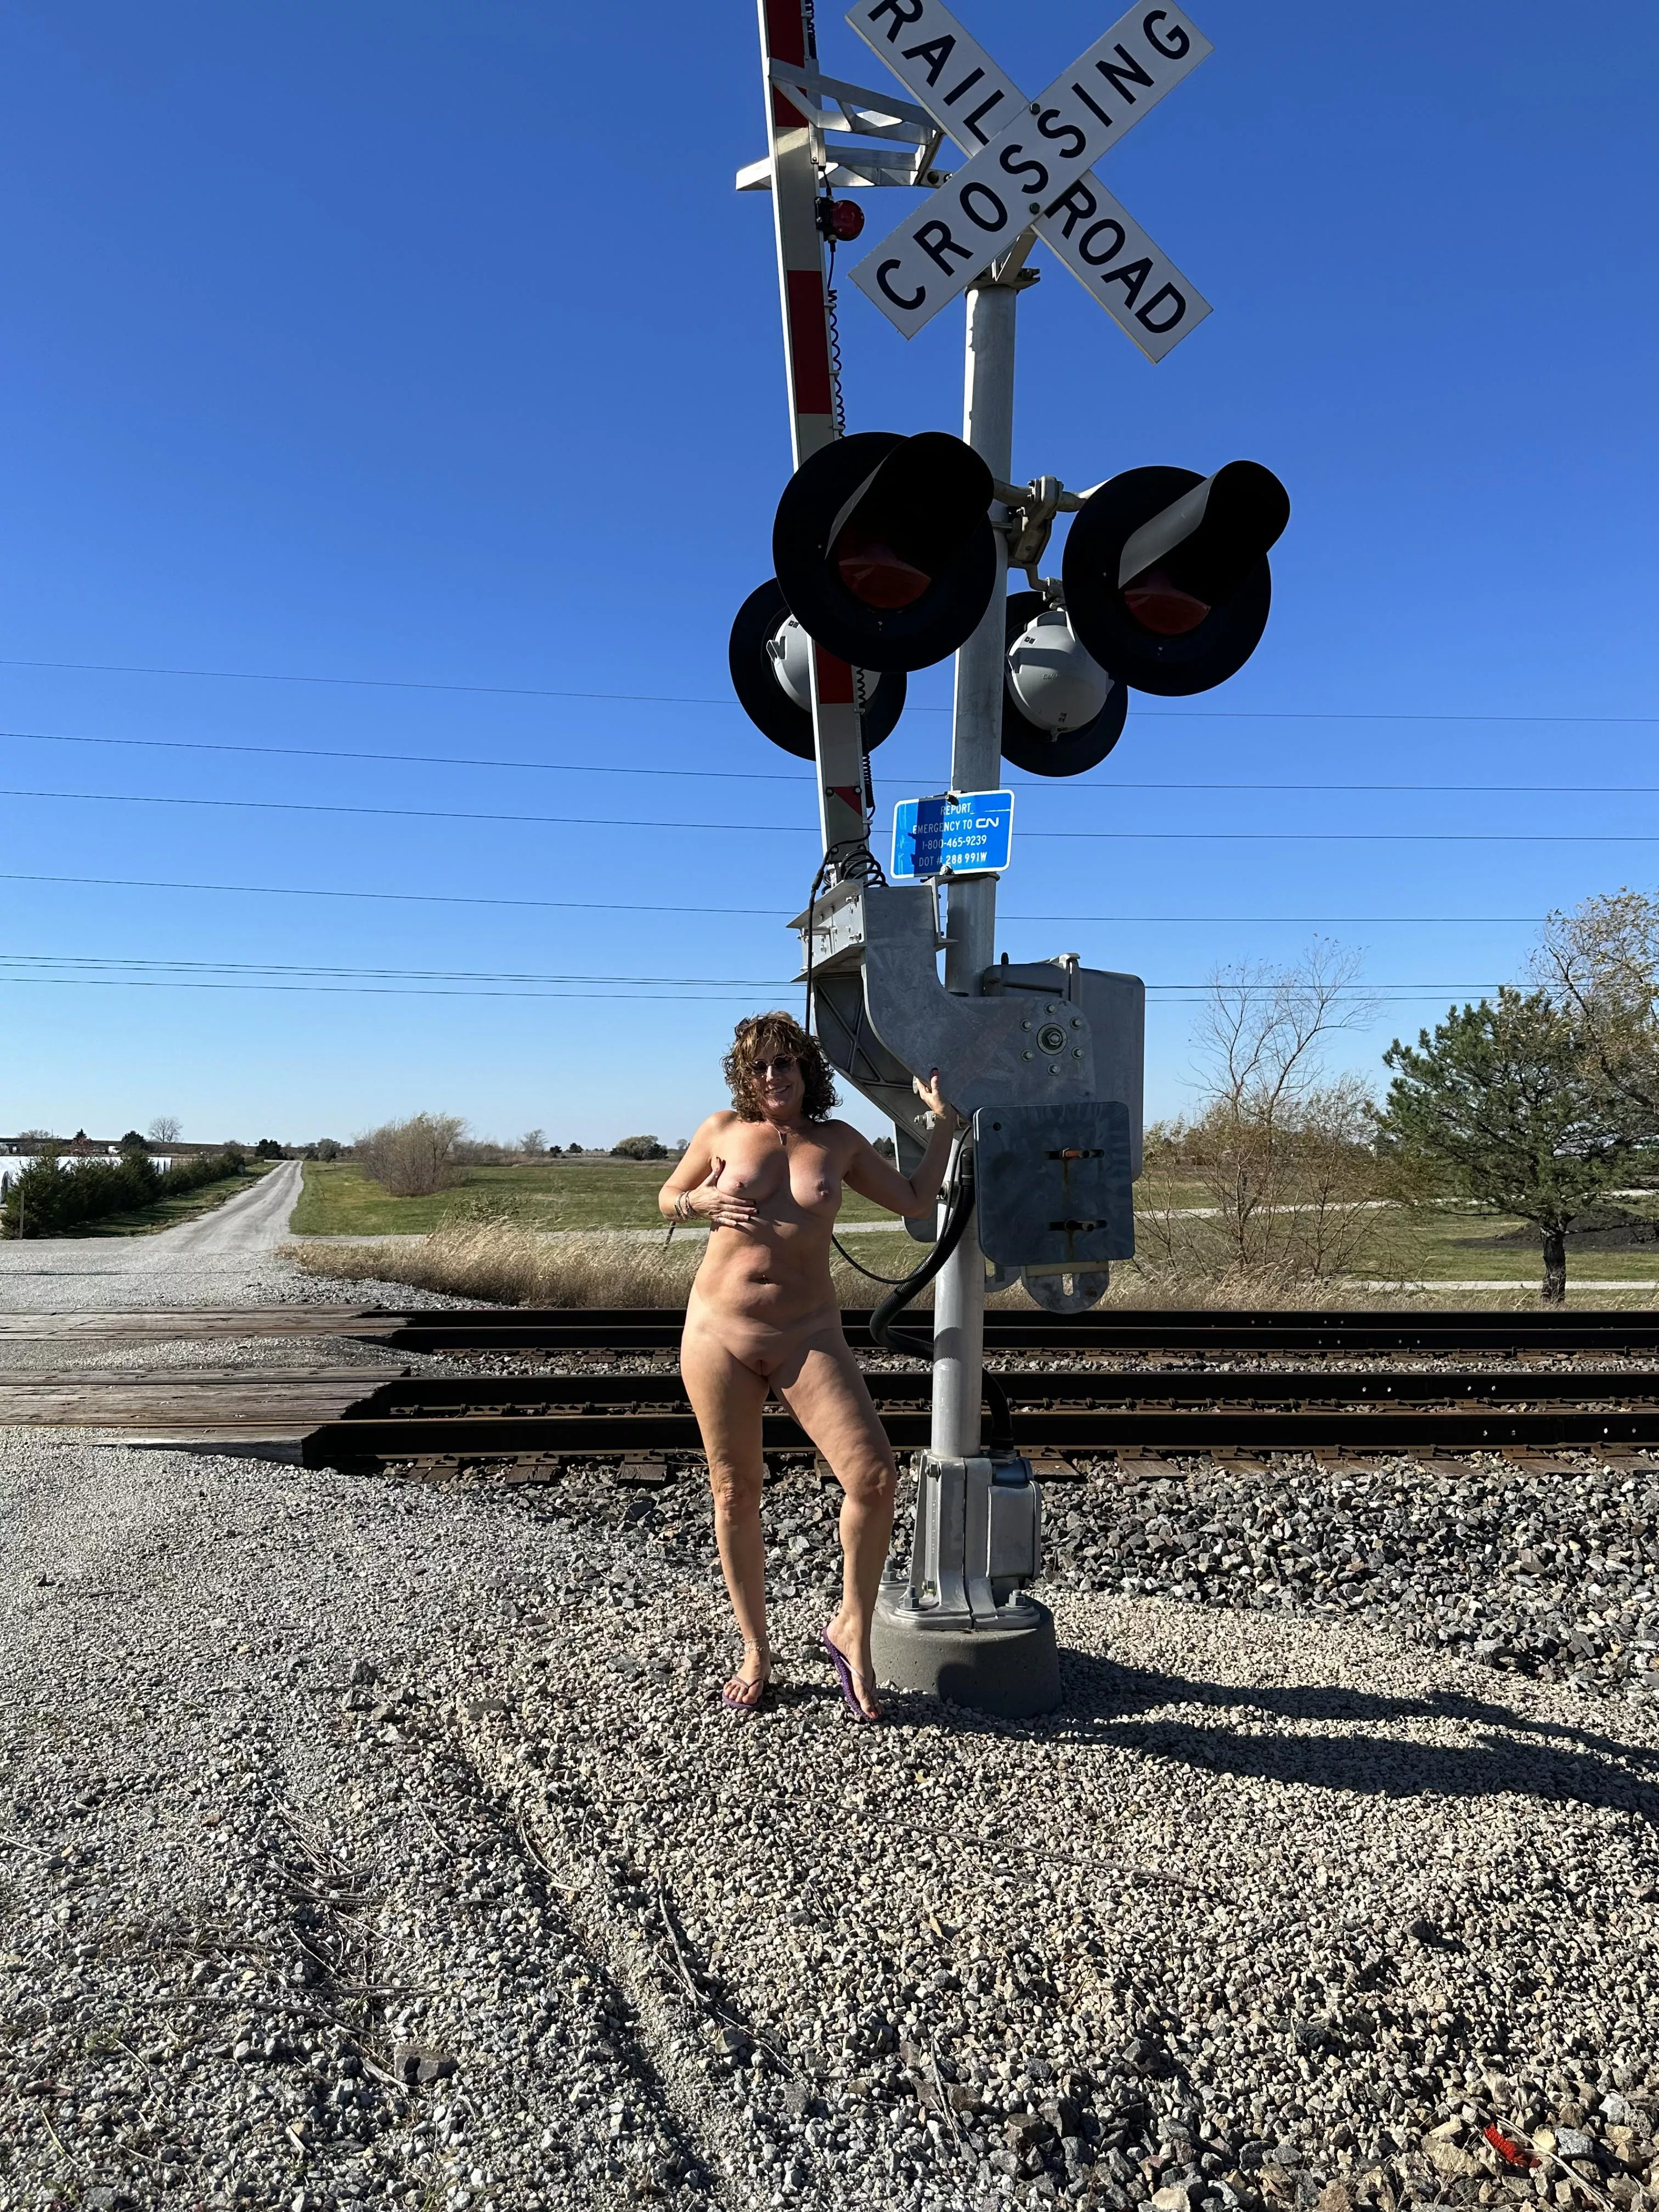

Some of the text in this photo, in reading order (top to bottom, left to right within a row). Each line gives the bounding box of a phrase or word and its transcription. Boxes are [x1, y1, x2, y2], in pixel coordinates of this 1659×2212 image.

[867, 0, 1187, 334] RAIL ROAD
[876, 10, 1190, 311] CROSSING
[940, 803, 972, 815] REPORT
[912, 817, 999, 834] EMERGENCY TO CN
[922, 834, 987, 850] 1-800-465-9239
[919, 856, 934, 867] DOT
[946, 854, 962, 865] 288
[965, 851, 988, 863] 991W
